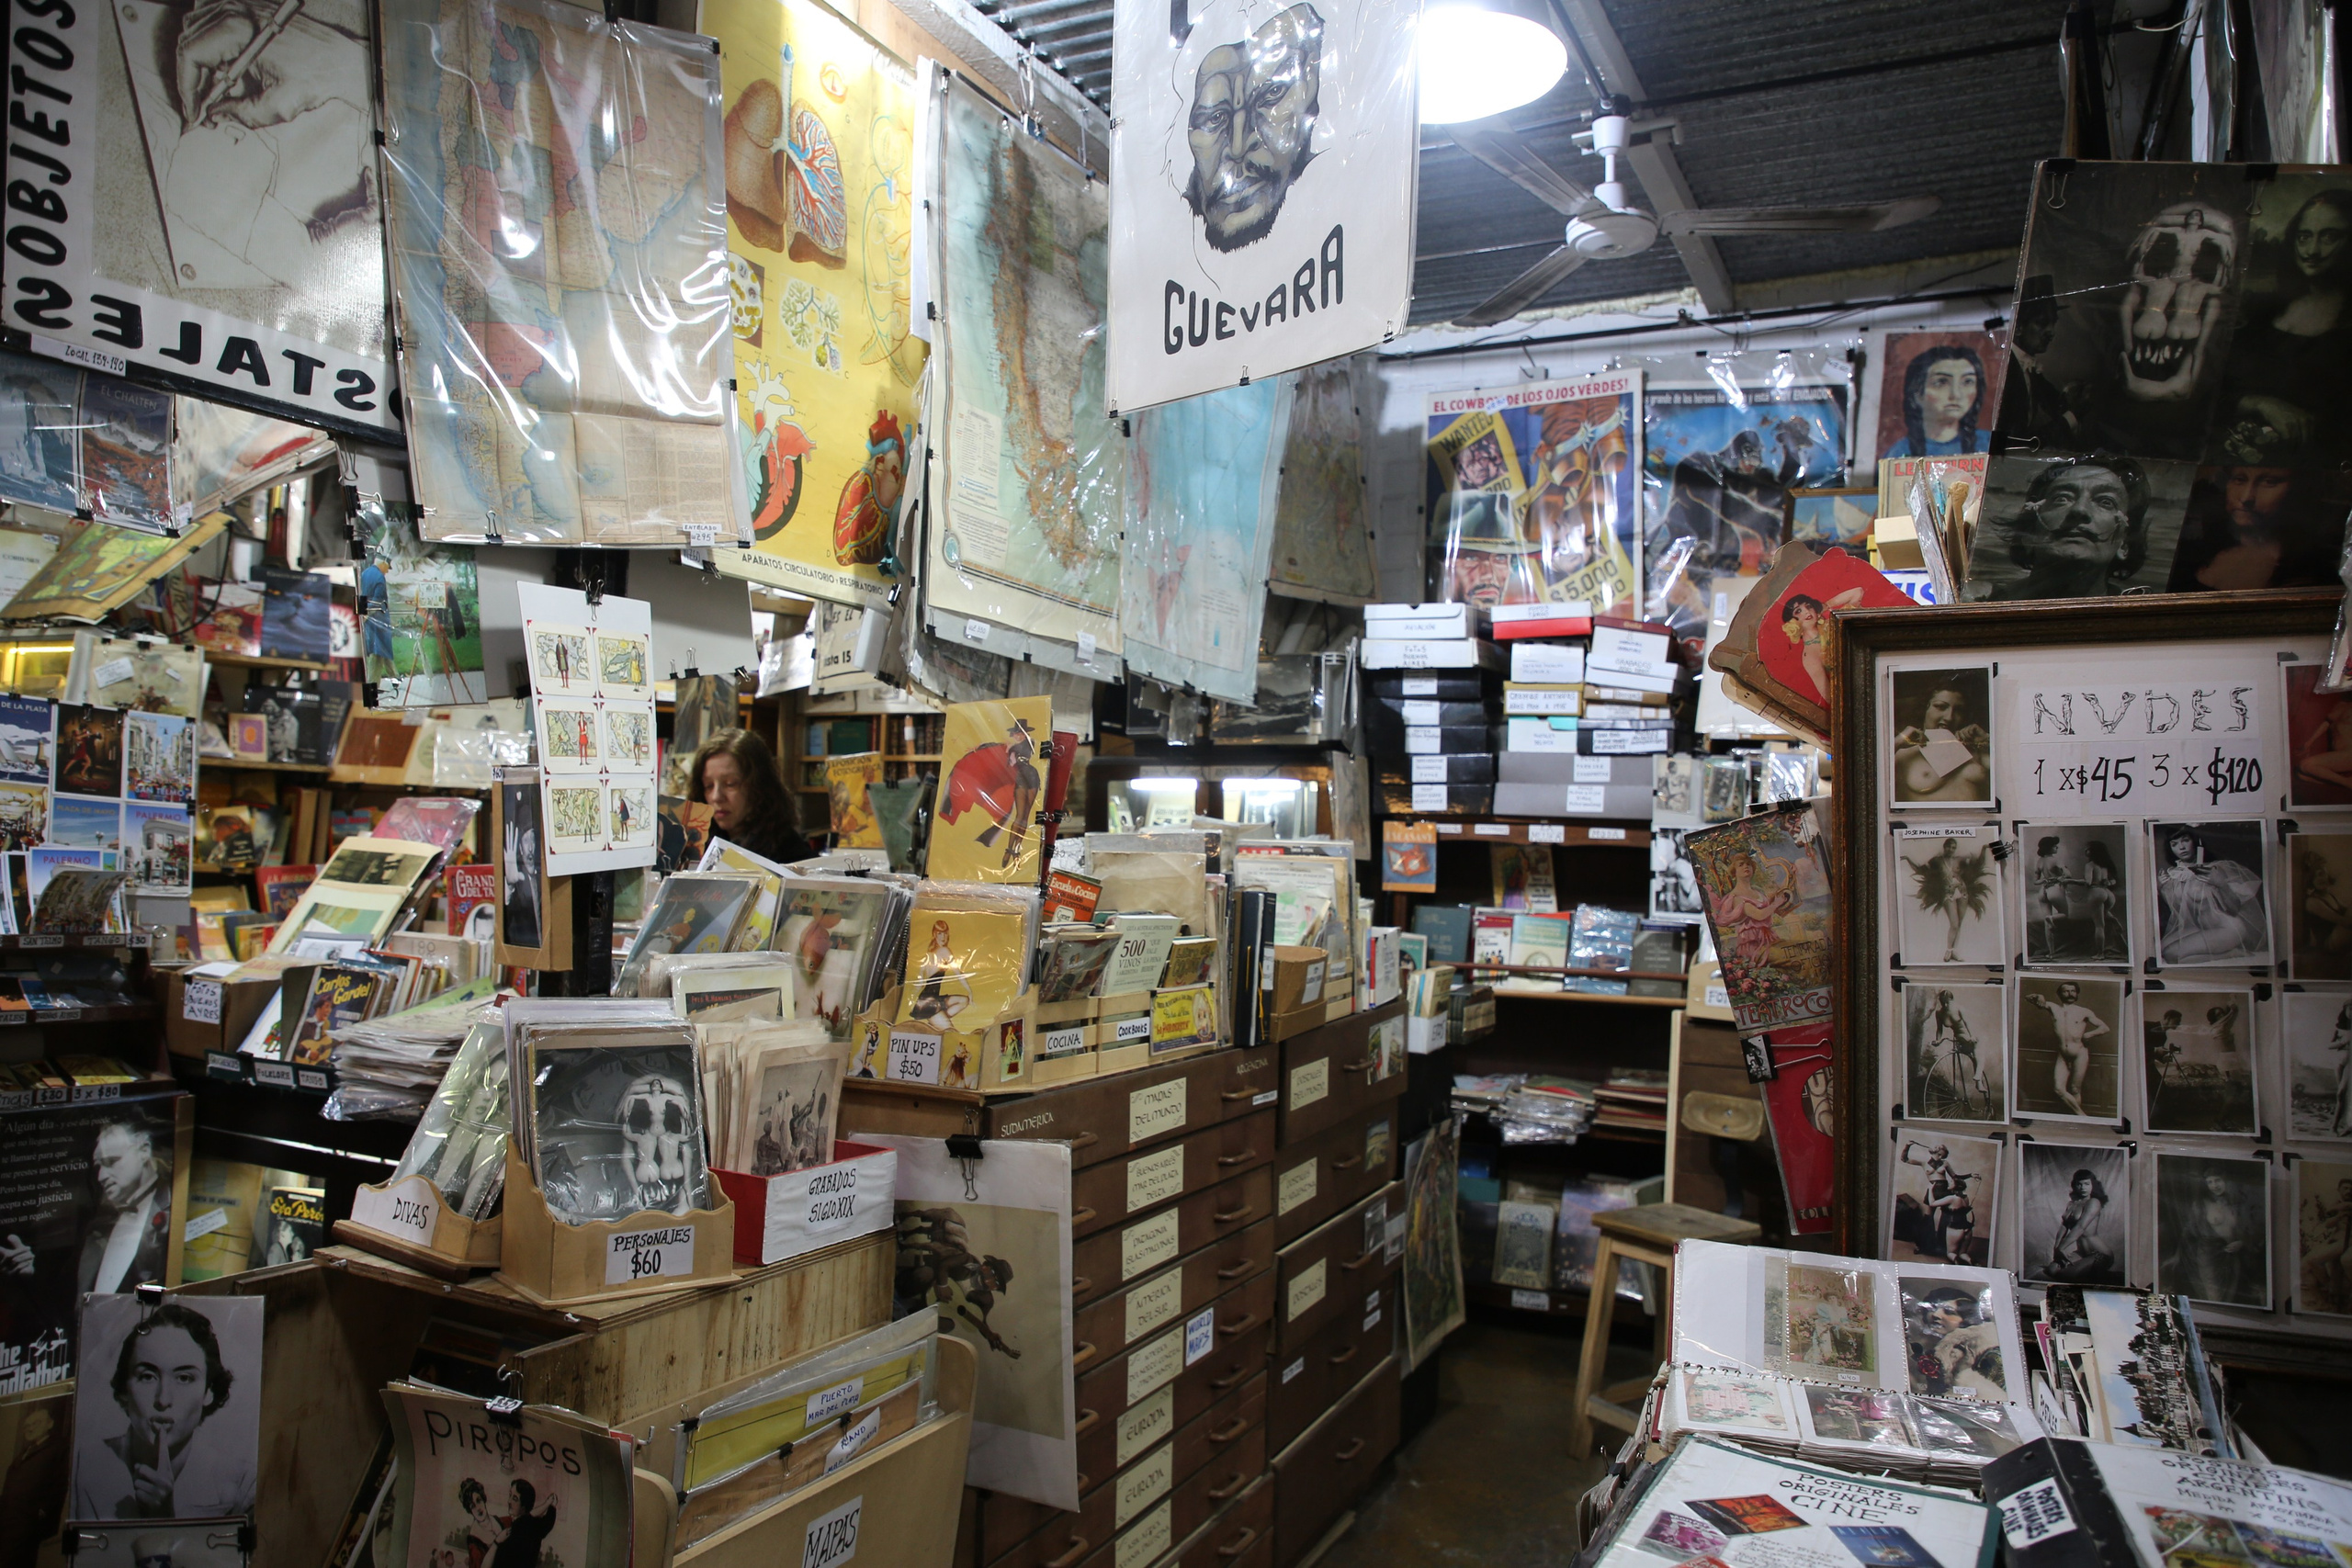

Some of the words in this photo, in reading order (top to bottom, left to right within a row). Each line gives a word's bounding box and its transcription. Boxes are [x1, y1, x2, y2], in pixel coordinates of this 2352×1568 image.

[1164, 224, 1342, 355] GUEVARA
[65, 344, 90, 363] LOCAL
[101, 384, 113, 398] EL
[115, 389, 158, 412] CHALTEN
[1433, 401, 1447, 412] EL
[1449, 396, 1501, 412] COWBO
[1507, 394, 1520, 405] DE
[1522, 391, 1543, 404] LOS
[1546, 388, 1575, 401] OJOS
[1578, 378, 1629, 396] VERDES!
[1439, 413, 1494, 454] WANTED
[742, 552, 783, 570] APARATOS
[784, 562, 835, 583] CIRCULATORIO
[839, 576, 884, 596] RESPIRATORIO
[1566, 558, 1619, 604] 5.000
[842, 650, 852, 663] 15
[25, 704, 48, 714] PLATA
[2033, 759, 2046, 795] 1
[2148, 753, 2171, 788] 3
[2181, 765, 2200, 785] x
[2205, 747, 2264, 806] $120
[155, 787, 184, 797] TELMO
[135, 810, 182, 822] PALERMO
[1905, 829, 1942, 837] JOSEPHINE
[42, 855, 91, 866] PALERMO
[467, 888, 483, 897] DEL
[1050, 876, 1071, 894] Escuela
[1075, 885, 1097, 900] Cocina
[23, 937, 41, 946] SAN
[42, 936, 62, 945] TELMO
[87, 936, 120, 944] TANGO
[1120, 939, 1147, 958] 500
[1118, 958, 1141, 969] VINOS
[191, 982, 218, 997] FOTOS
[315, 975, 352, 996] Carlos
[333, 983, 372, 1006] Gardel
[187, 1008, 220, 1021] AYRES
[1733, 995, 1804, 1026] TEATRO
[890, 1038, 908, 1057] PIN
[912, 1040, 935, 1058] UPS
[1046, 1032, 1082, 1051] COCINA
[300, 1073, 324, 1086] TANGO
[899, 1057, 922, 1079] $50
[40, 1090, 63, 1101] $30
[74, 1089, 81, 1100] 3
[85, 1090, 93, 1100] x
[97, 1087, 118, 1097] $80
[1143, 1088, 1173, 1106] MAPAS
[1001, 1112, 1055, 1138] SUDAMERICA
[1135, 1113, 1154, 1125] DEL
[1154, 1102, 1182, 1120] MUNDO
[49, 1159, 88, 1174] servicio
[808, 1168, 857, 1197] GRABADOS
[36, 1190, 73, 1208] justicia
[392, 1196, 430, 1229] DIVAS
[614, 1228, 693, 1253] PERSONAJES
[630, 1249, 662, 1279] $60
[1136, 1284, 1171, 1311] AMERICA
[1154, 1302, 1170, 1320] SUR
[1188, 1312, 1212, 1335] WORLD
[1186, 1330, 1211, 1359] MAPS
[820, 1384, 854, 1405] PUERTO
[808, 1408, 824, 1422] MAR
[826, 1404, 839, 1415] DEL
[841, 1393, 860, 1407] PLATA
[1125, 1406, 1166, 1441] EUROPA
[423, 1409, 582, 1476] PIROPOS
[2177, 1454, 2281, 1480] POSTERS
[1125, 1467, 1165, 1505] EUROPA
[1797, 1473, 1903, 1502] POSTERS
[2177, 1476, 2325, 1512] ARGENTINO
[2192, 1472, 2275, 1494] CINE
[1779, 1481, 1920, 1515] ORIGINALES
[1791, 1495, 1889, 1524] CINE
[2036, 1485, 2066, 1525] POSTERS
[2004, 1506, 2022, 1535] CINE
[803, 1508, 861, 1568] MAPAS
